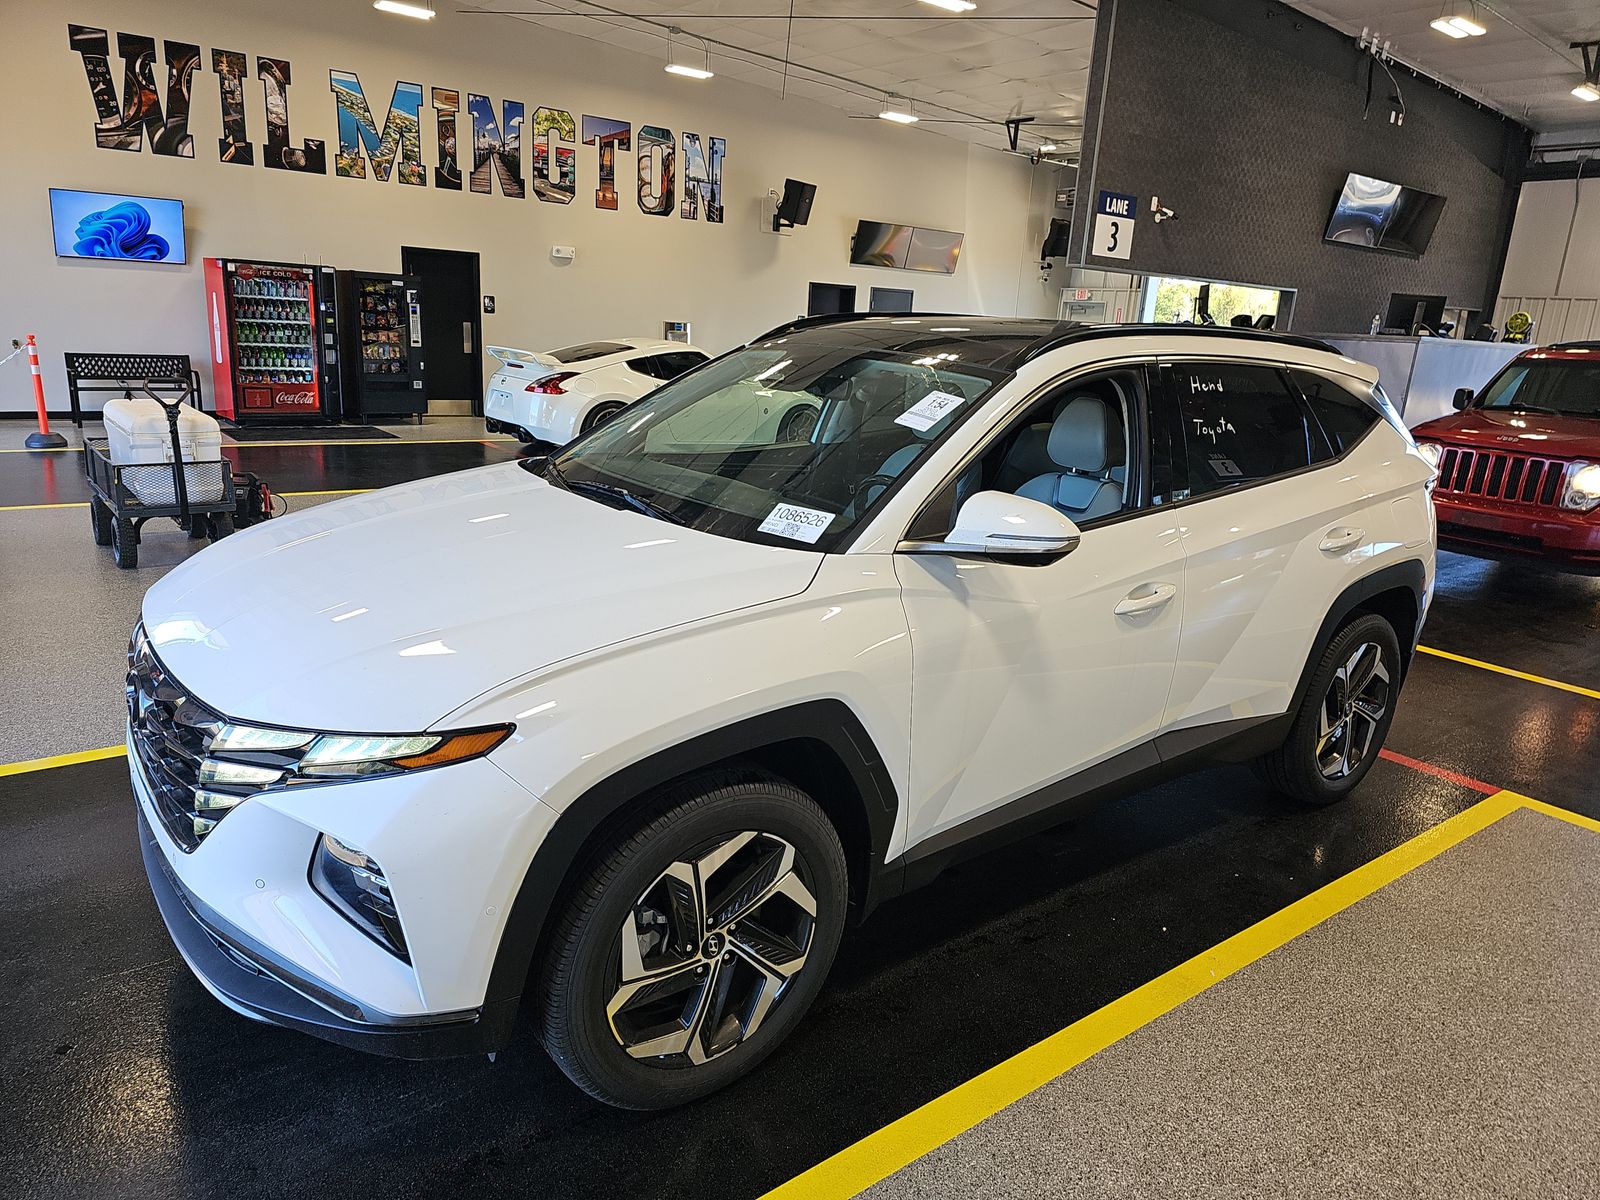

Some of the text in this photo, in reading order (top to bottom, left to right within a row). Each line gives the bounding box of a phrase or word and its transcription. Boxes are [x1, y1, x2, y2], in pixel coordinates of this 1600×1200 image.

[68, 24, 727, 223] WILMINGTON
[1105, 196, 1130, 216] LANE
[1107, 221, 1120, 252] 3
[1192, 416, 1236, 445] Toyota
[1496, 435, 1519, 443] Jeep
[773, 506, 828, 528] 1086526
